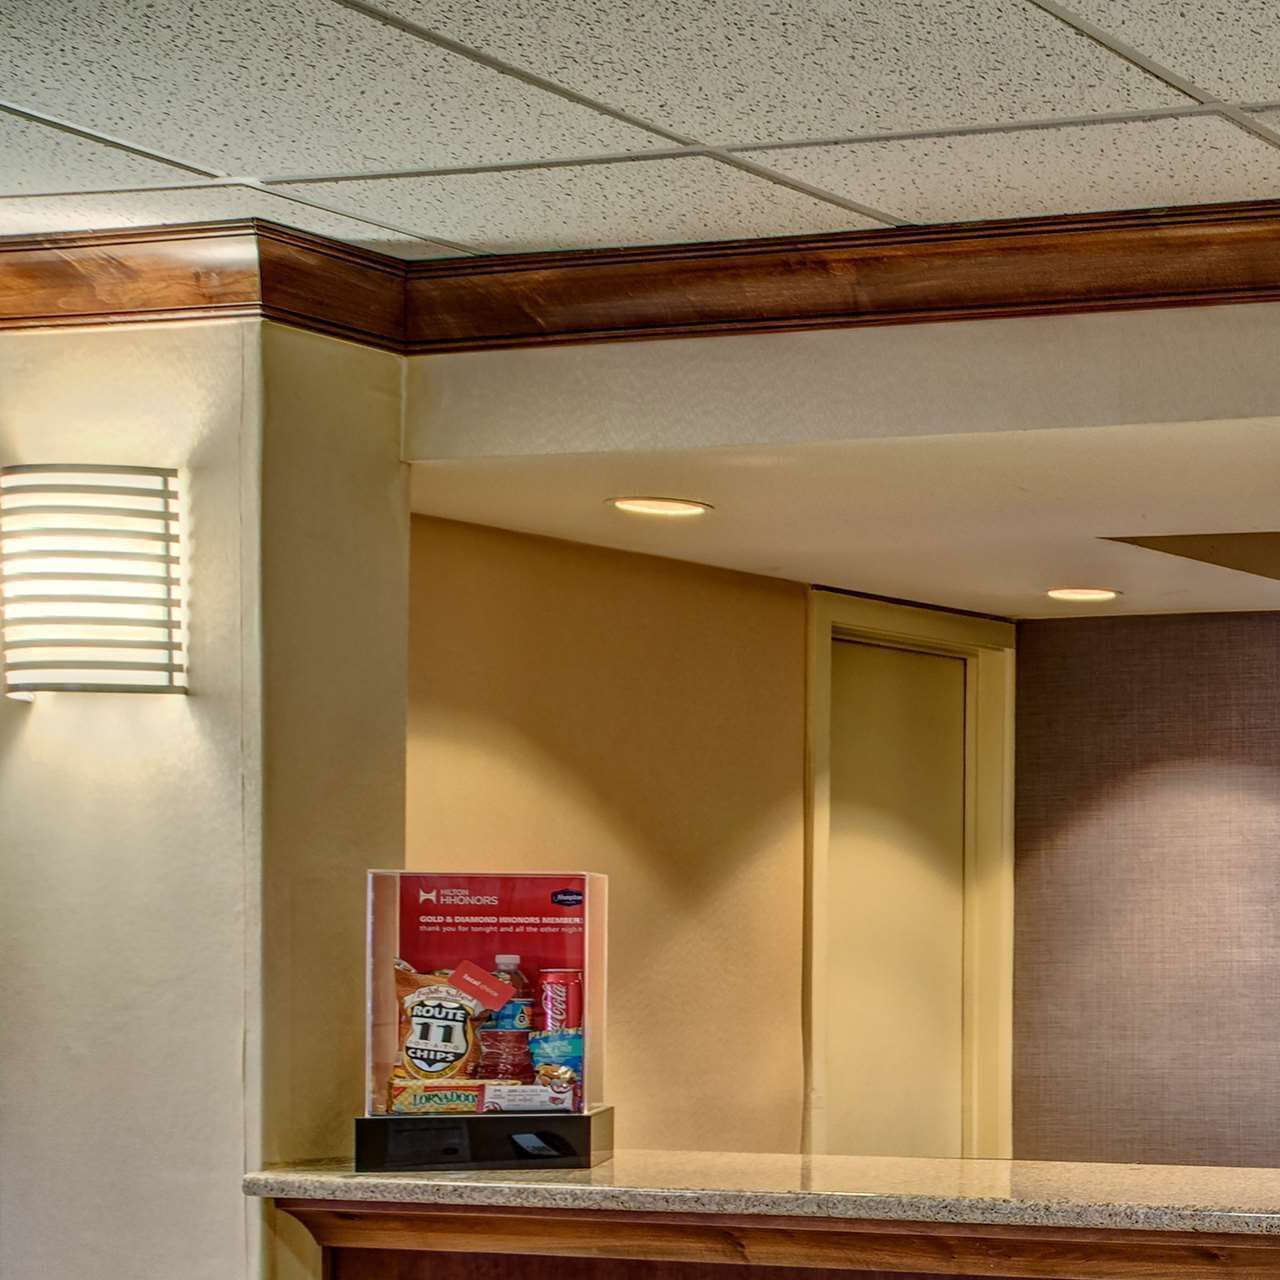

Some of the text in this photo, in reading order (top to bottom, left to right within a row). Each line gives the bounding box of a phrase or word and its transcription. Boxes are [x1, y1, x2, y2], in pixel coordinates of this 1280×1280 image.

[439, 896, 499, 905] HHONORS
[470, 926, 498, 934] tonight
[412, 1005, 466, 1021] ROUTE
[416, 1021, 456, 1043] 11
[407, 1048, 456, 1062] CHIPS
